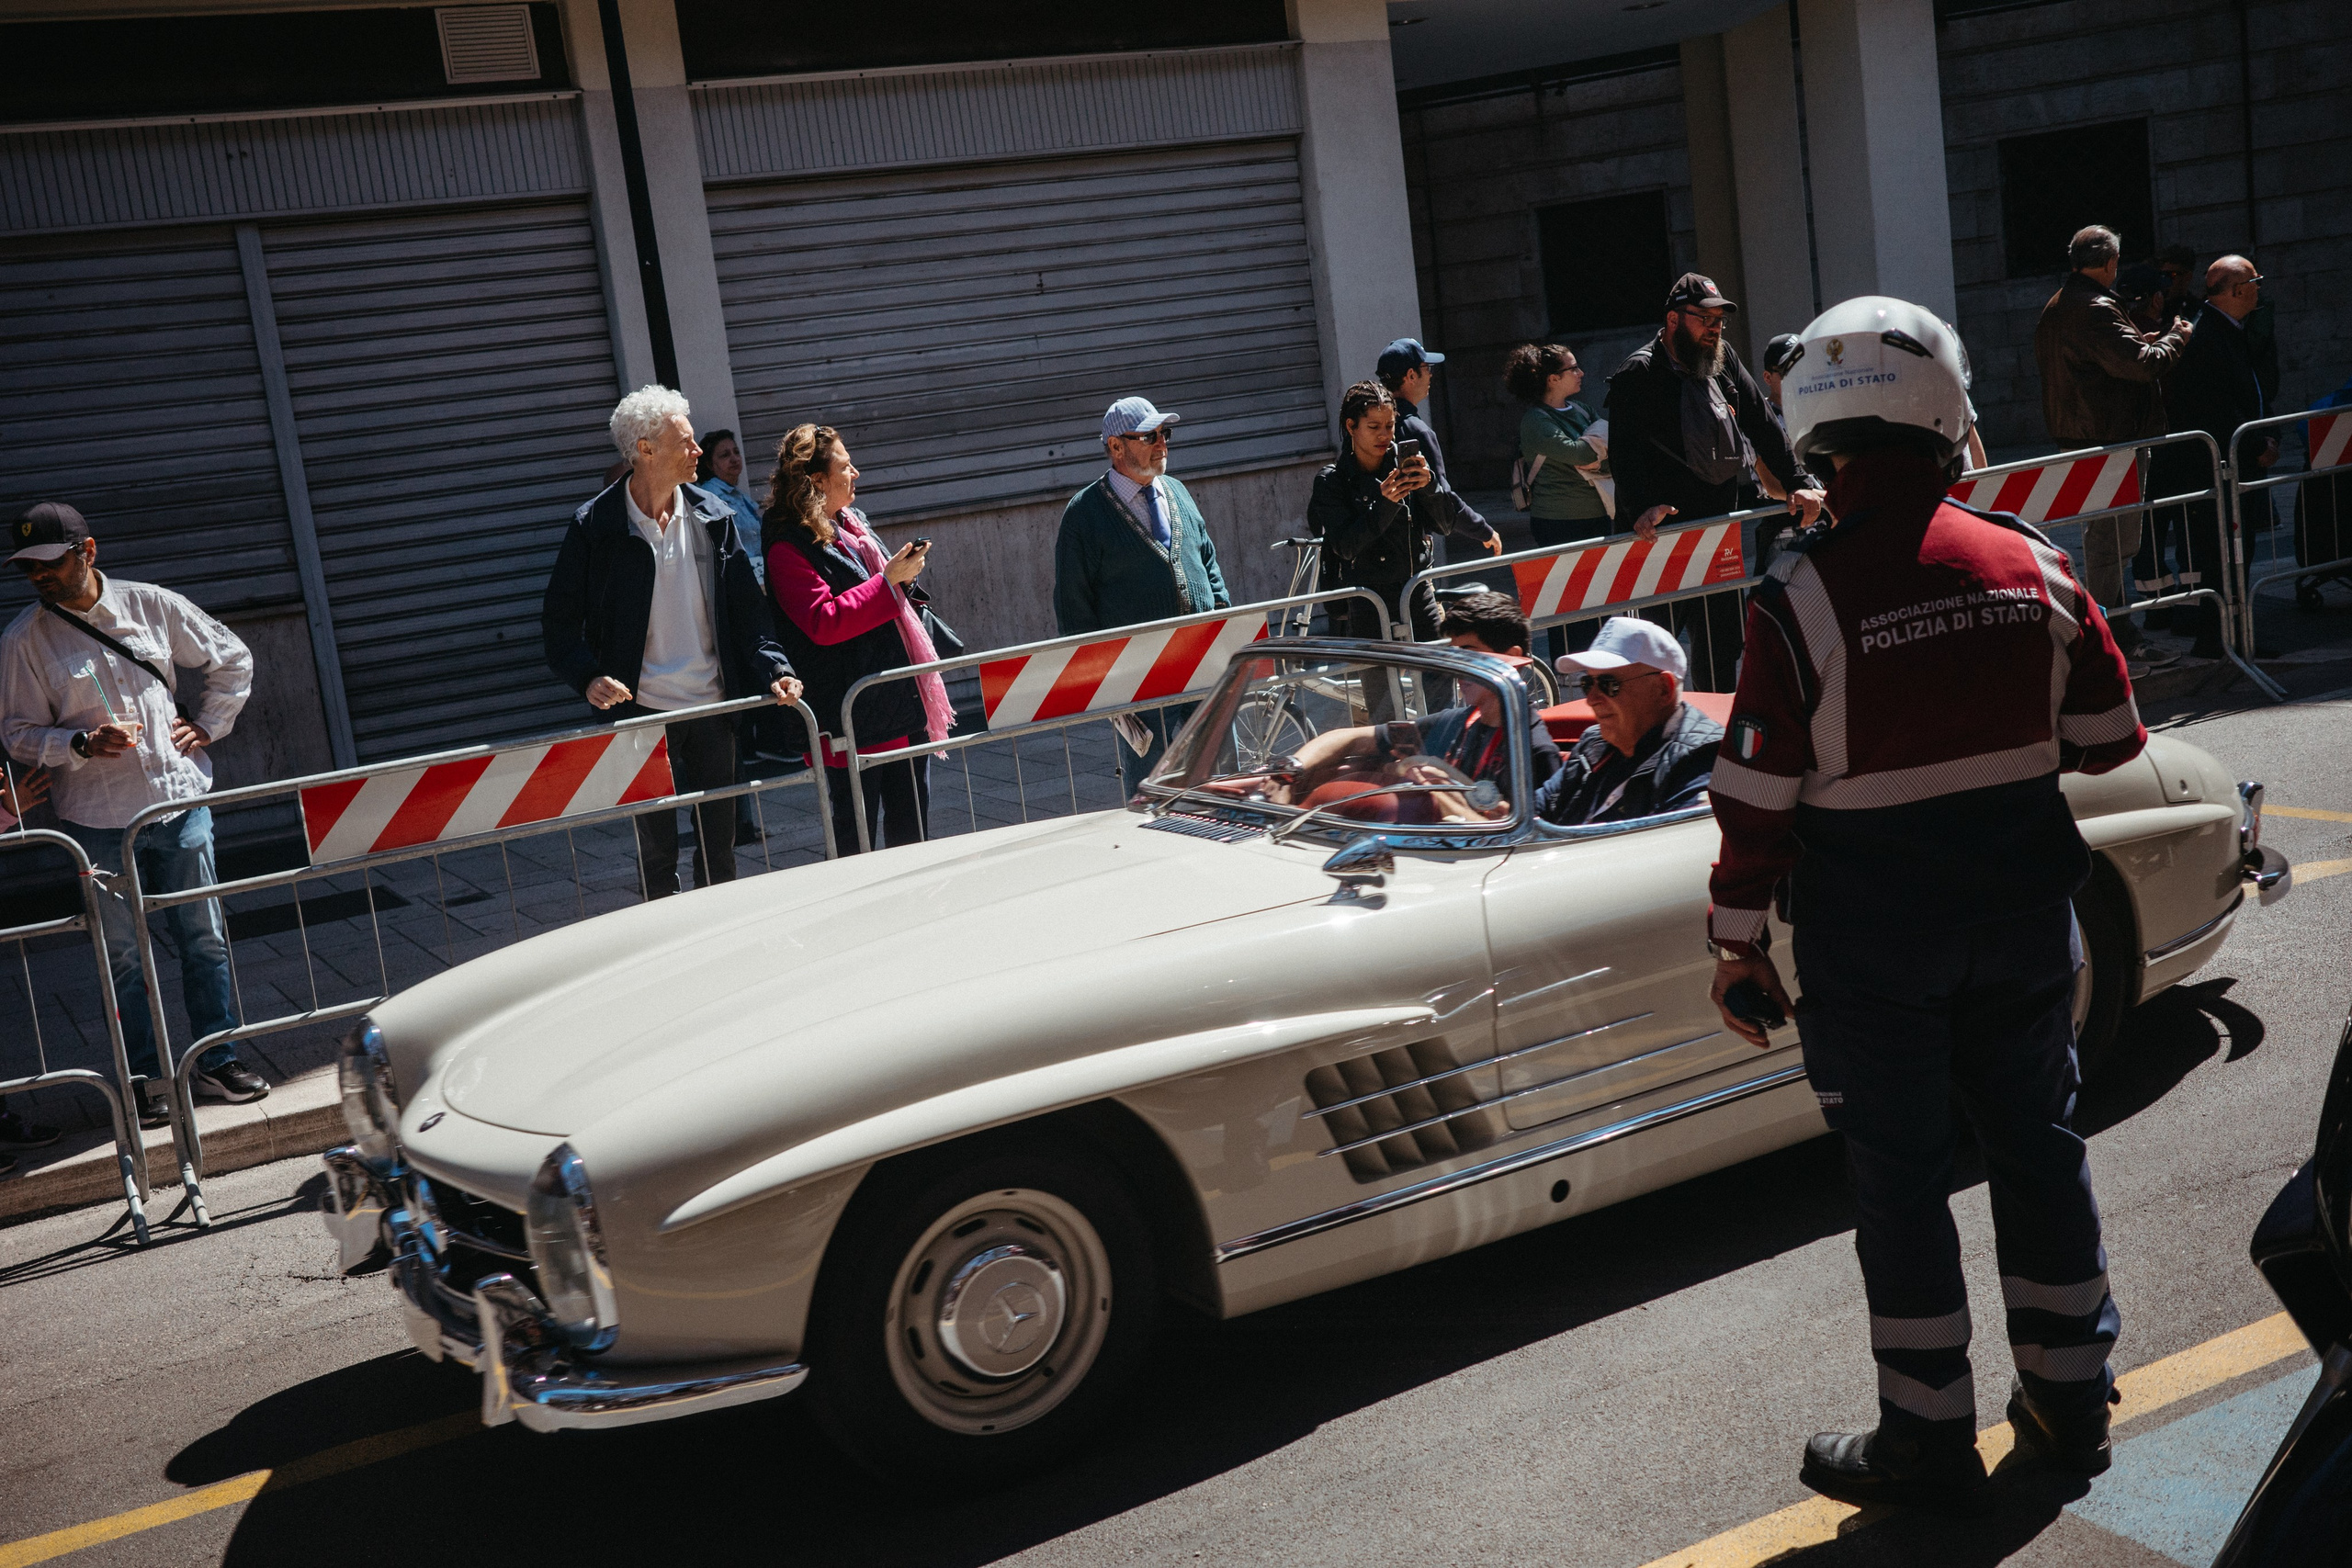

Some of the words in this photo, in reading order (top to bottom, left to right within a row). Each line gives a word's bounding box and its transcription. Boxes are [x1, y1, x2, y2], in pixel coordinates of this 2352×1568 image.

[1798, 380, 1836, 395] POLIZIA
[1839, 378, 1853, 388] DI
[1858, 373, 1896, 385] STATO
[1860, 595, 1965, 631] ASSOCIAZIONE
[1966, 588, 2040, 604] NAZIONALE
[1860, 615, 1949, 654] POLIZIA
[1952, 610, 1974, 631] DI
[1981, 604, 2042, 626] STATO
